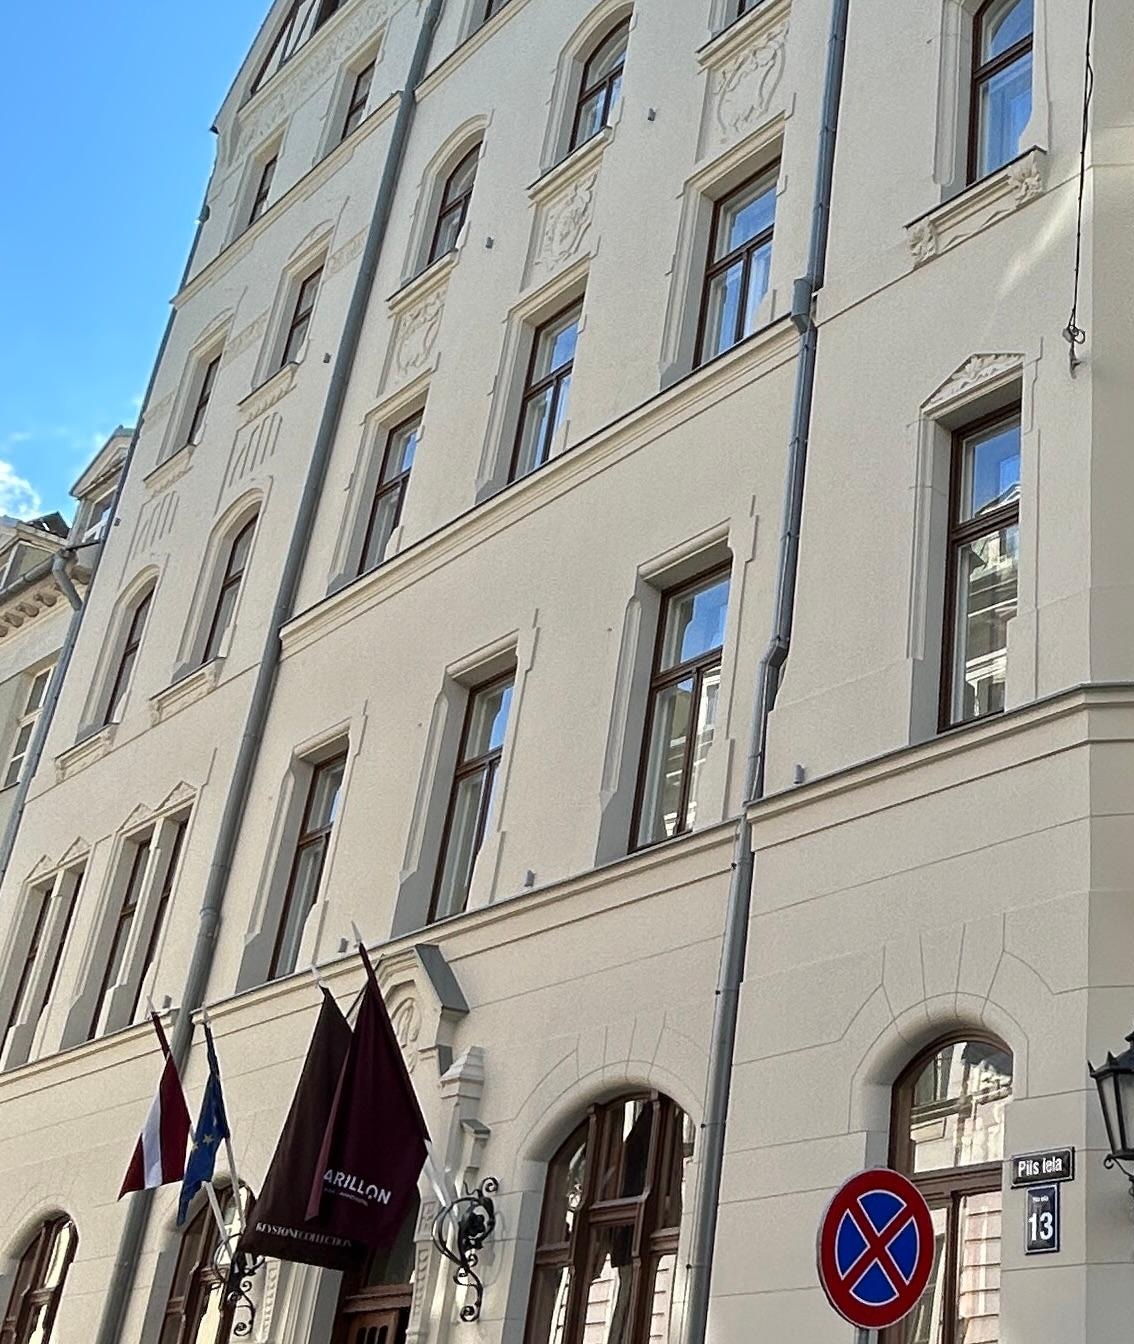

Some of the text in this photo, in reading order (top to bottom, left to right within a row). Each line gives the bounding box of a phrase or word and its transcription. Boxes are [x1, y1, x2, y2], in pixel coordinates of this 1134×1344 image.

[1018, 1157, 1062, 1177] Pils iela
[1028, 1212, 1053, 1241] 13
